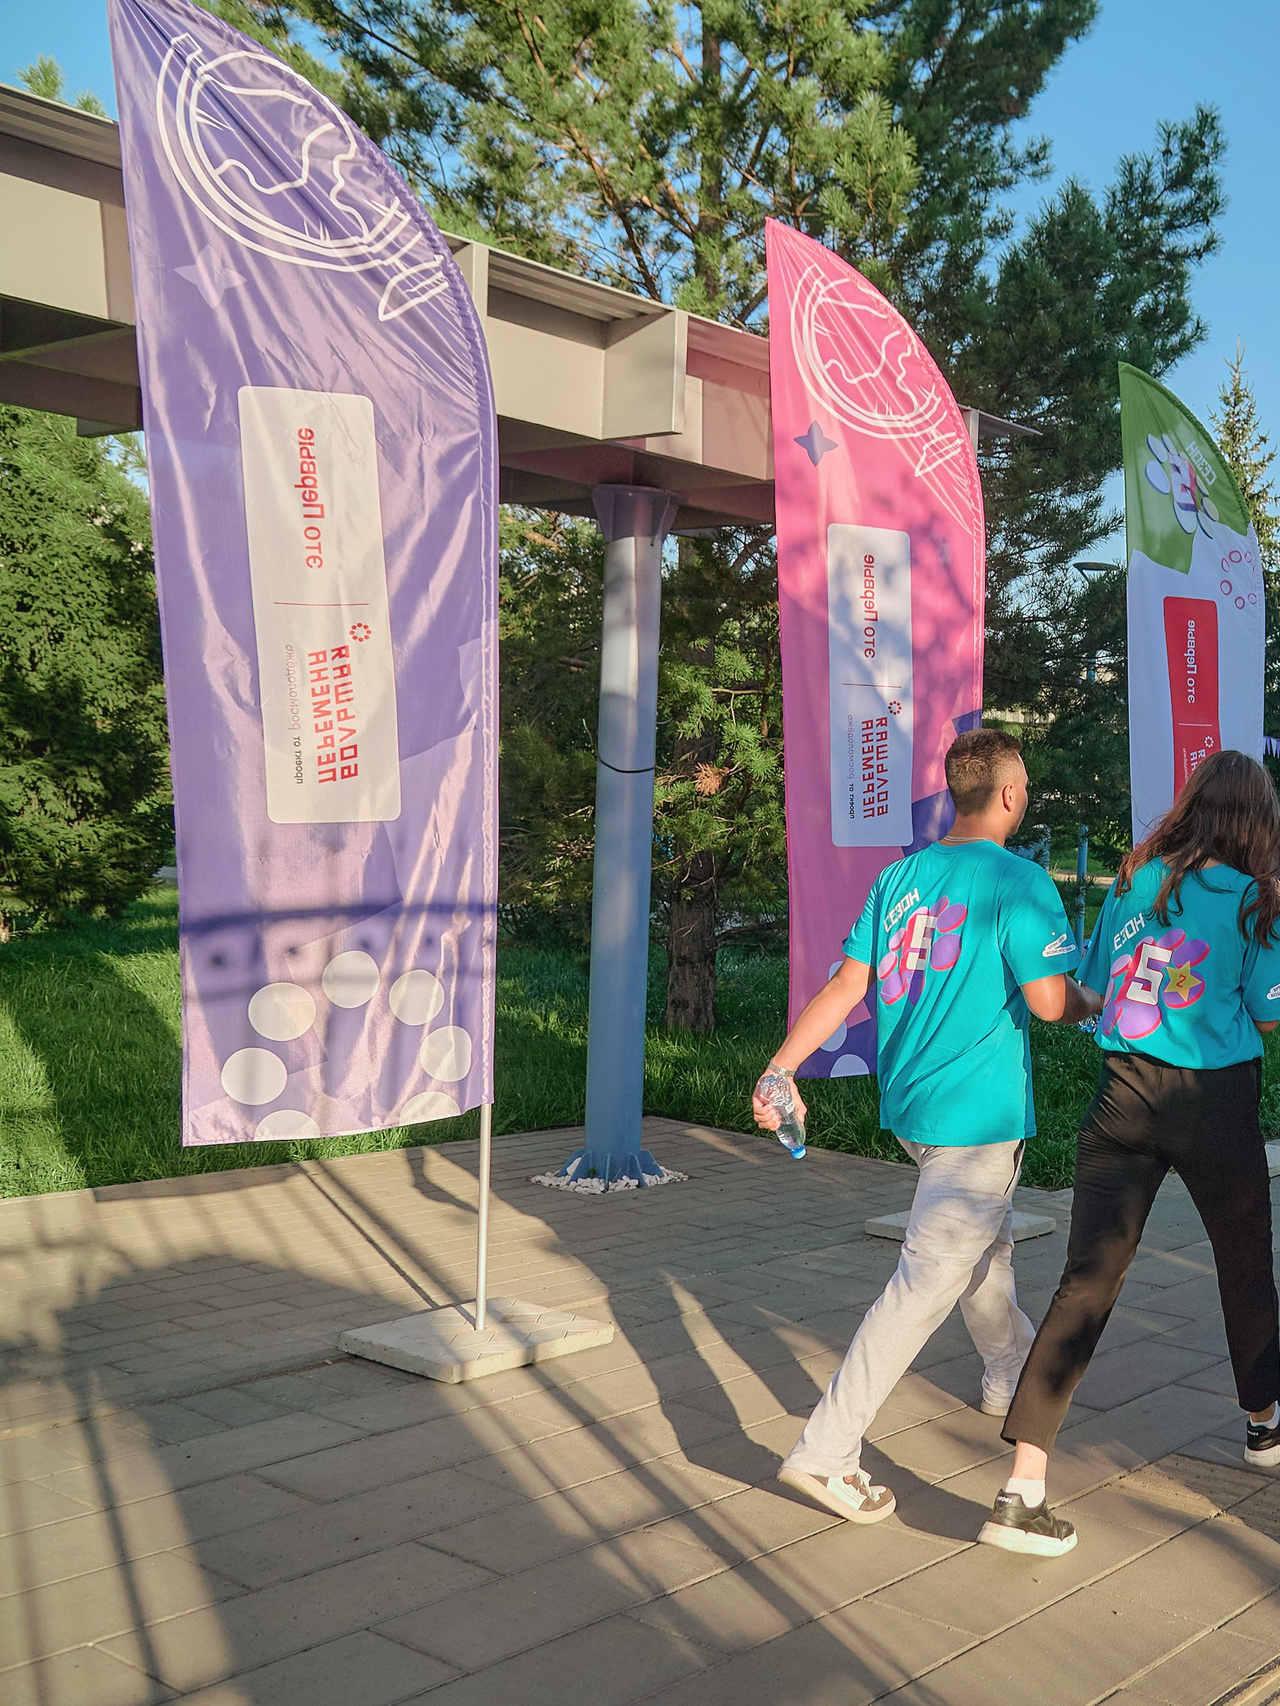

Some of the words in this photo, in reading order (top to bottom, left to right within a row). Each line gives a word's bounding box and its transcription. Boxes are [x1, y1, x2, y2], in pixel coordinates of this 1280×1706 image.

[882, 887, 921, 933] СЕЗОН
[1112, 912, 1146, 954] ЕЗОН
[905, 914, 939, 972] 5
[1125, 942, 1174, 1006] 5
